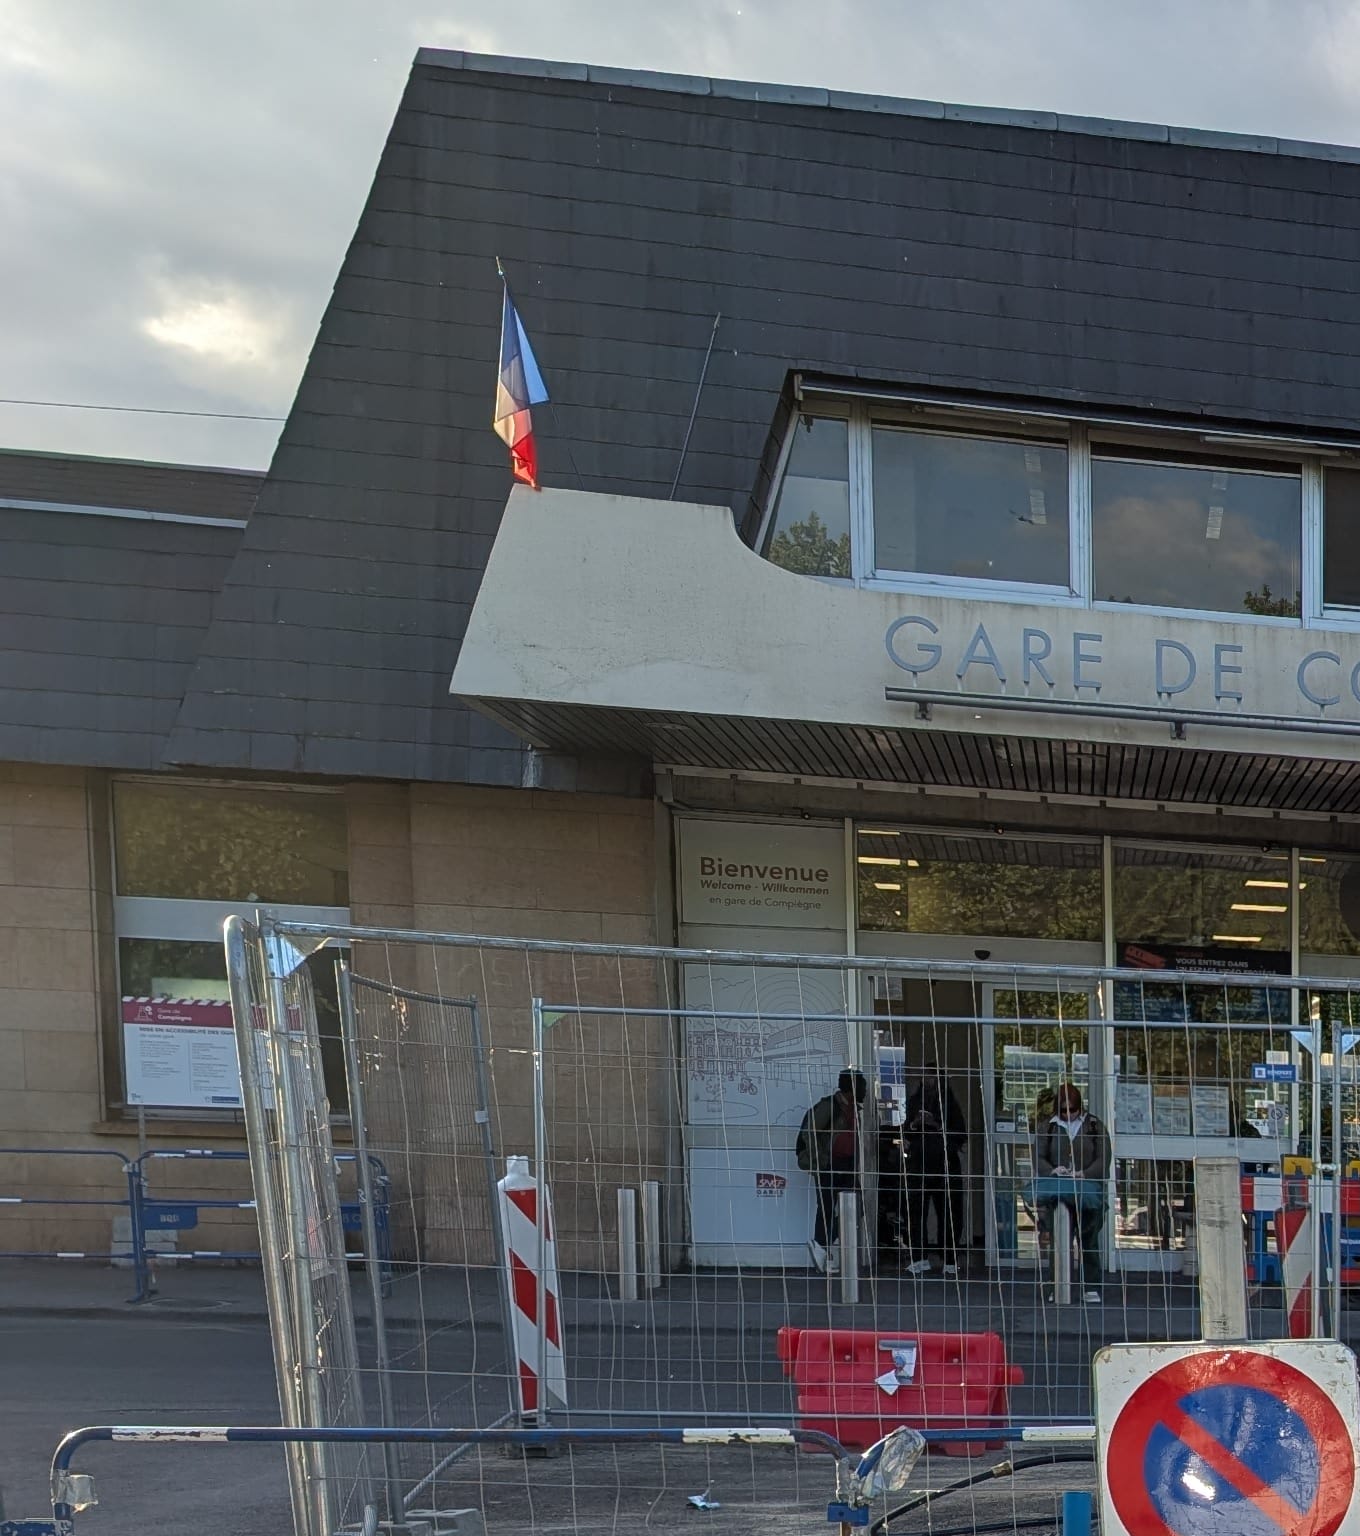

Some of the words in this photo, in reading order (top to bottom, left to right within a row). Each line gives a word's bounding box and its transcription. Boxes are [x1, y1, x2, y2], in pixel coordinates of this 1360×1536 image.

[885, 615, 1103, 689] GARE
[1154, 638, 1244, 700] DE
[700, 856, 829, 882] Bienvenue
[700, 879, 752, 891] Welcome
[762, 882, 829, 895] Willkommen
[724, 897, 746, 907] gare
[748, 896, 761, 906] de
[764, 897, 821, 910] Compiègne
[1175, 957, 1197, 965] VOUS
[1198, 958, 1227, 967] ENTREZ
[1228, 960, 1249, 968] DANS
